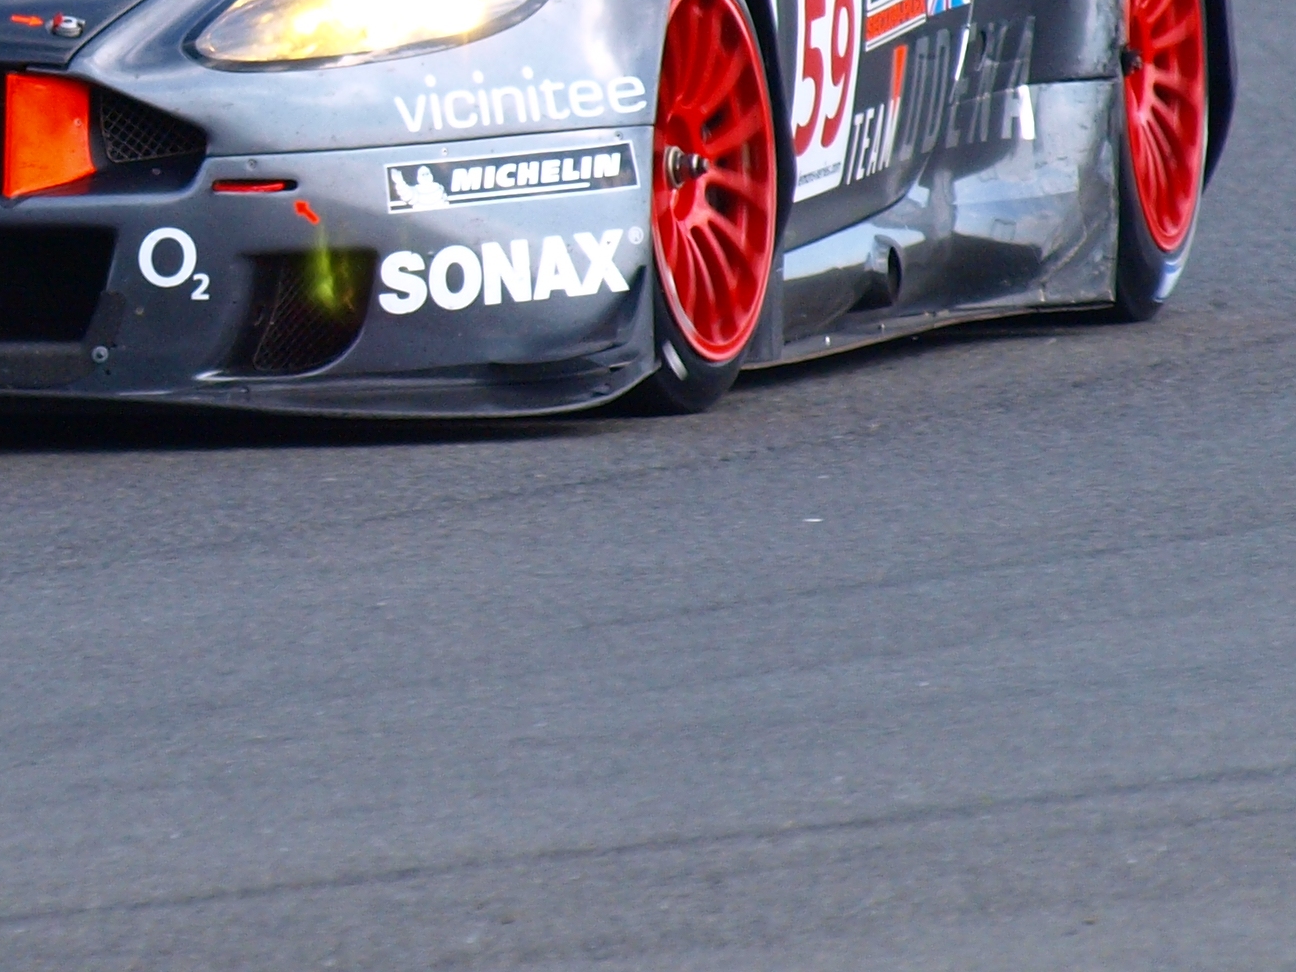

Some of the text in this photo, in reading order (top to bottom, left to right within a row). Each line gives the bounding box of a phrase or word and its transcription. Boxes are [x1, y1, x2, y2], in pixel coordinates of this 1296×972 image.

[394, 66, 648, 132] vicinitee
[450, 152, 622, 192] MICHELIN
[379, 229, 630, 315] SONAX
